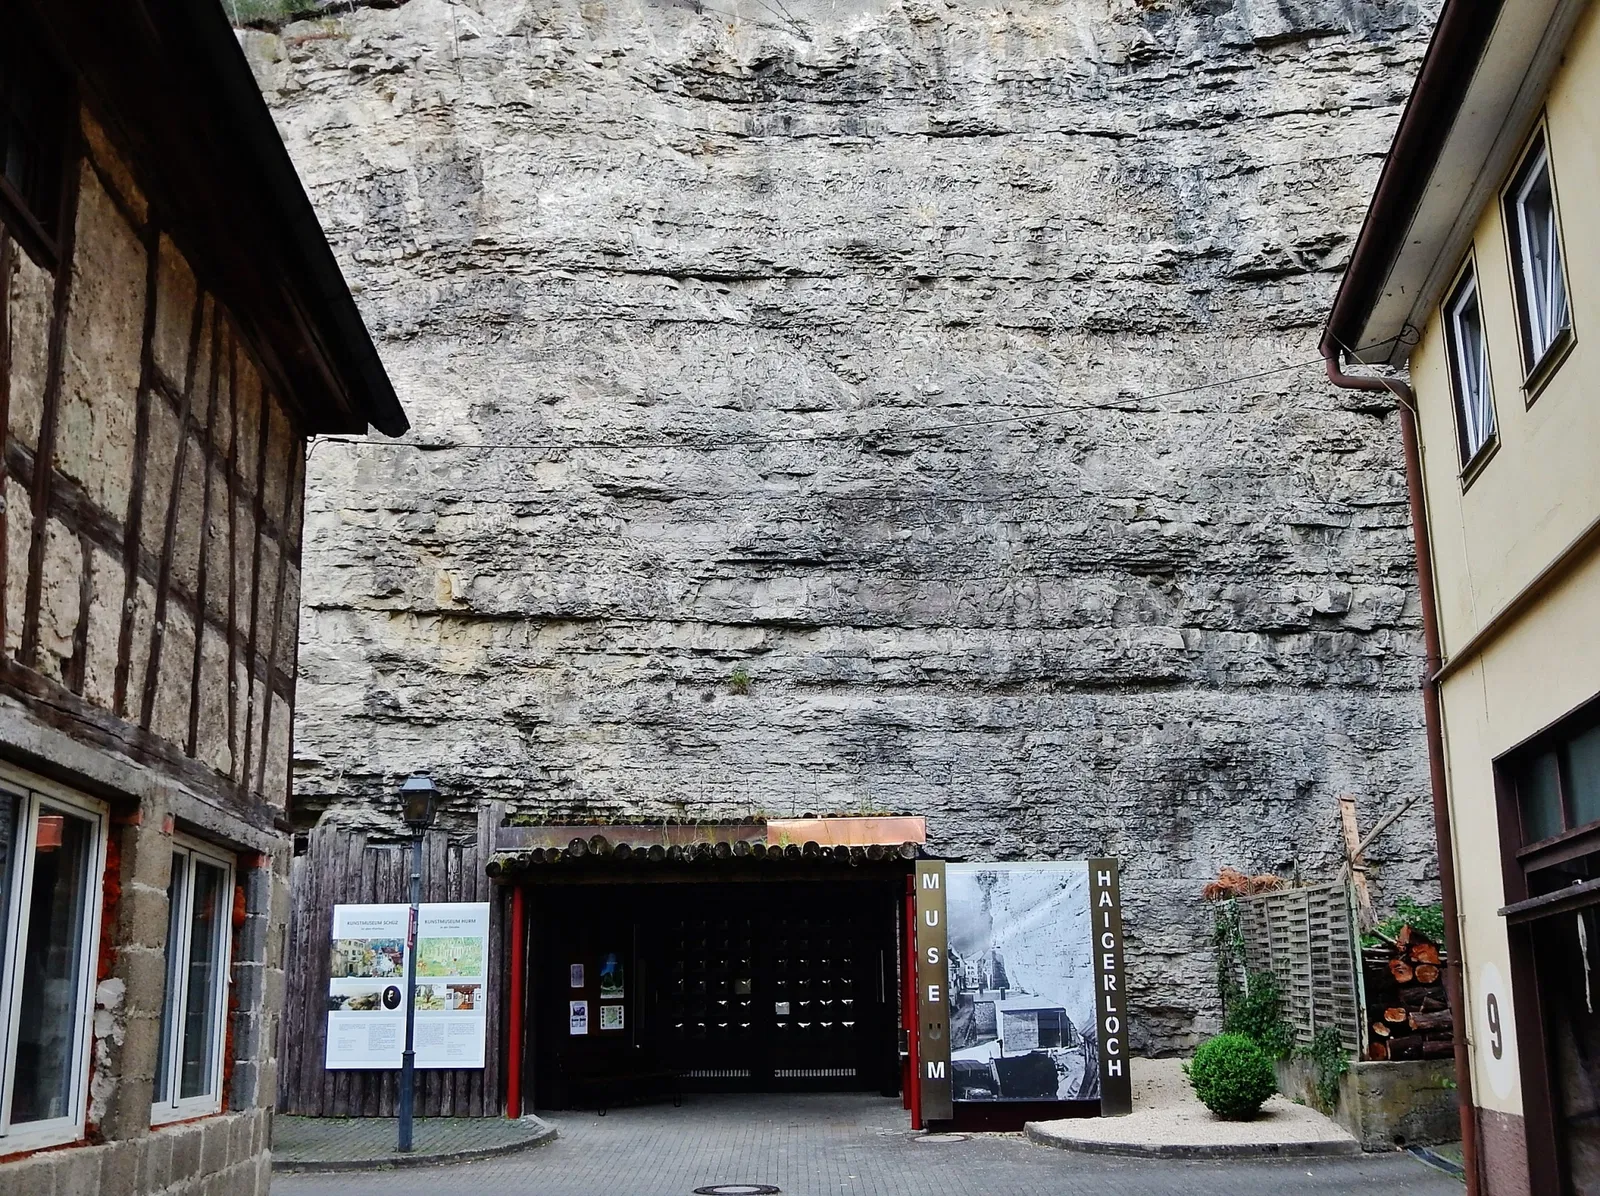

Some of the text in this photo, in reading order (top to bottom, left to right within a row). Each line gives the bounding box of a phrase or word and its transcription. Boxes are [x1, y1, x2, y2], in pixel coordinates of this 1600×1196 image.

[922, 872, 945, 1079] MUSEUM
[1097, 870, 1122, 1077] HAIGERLOCH
[1486, 992, 1503, 1060] 9
